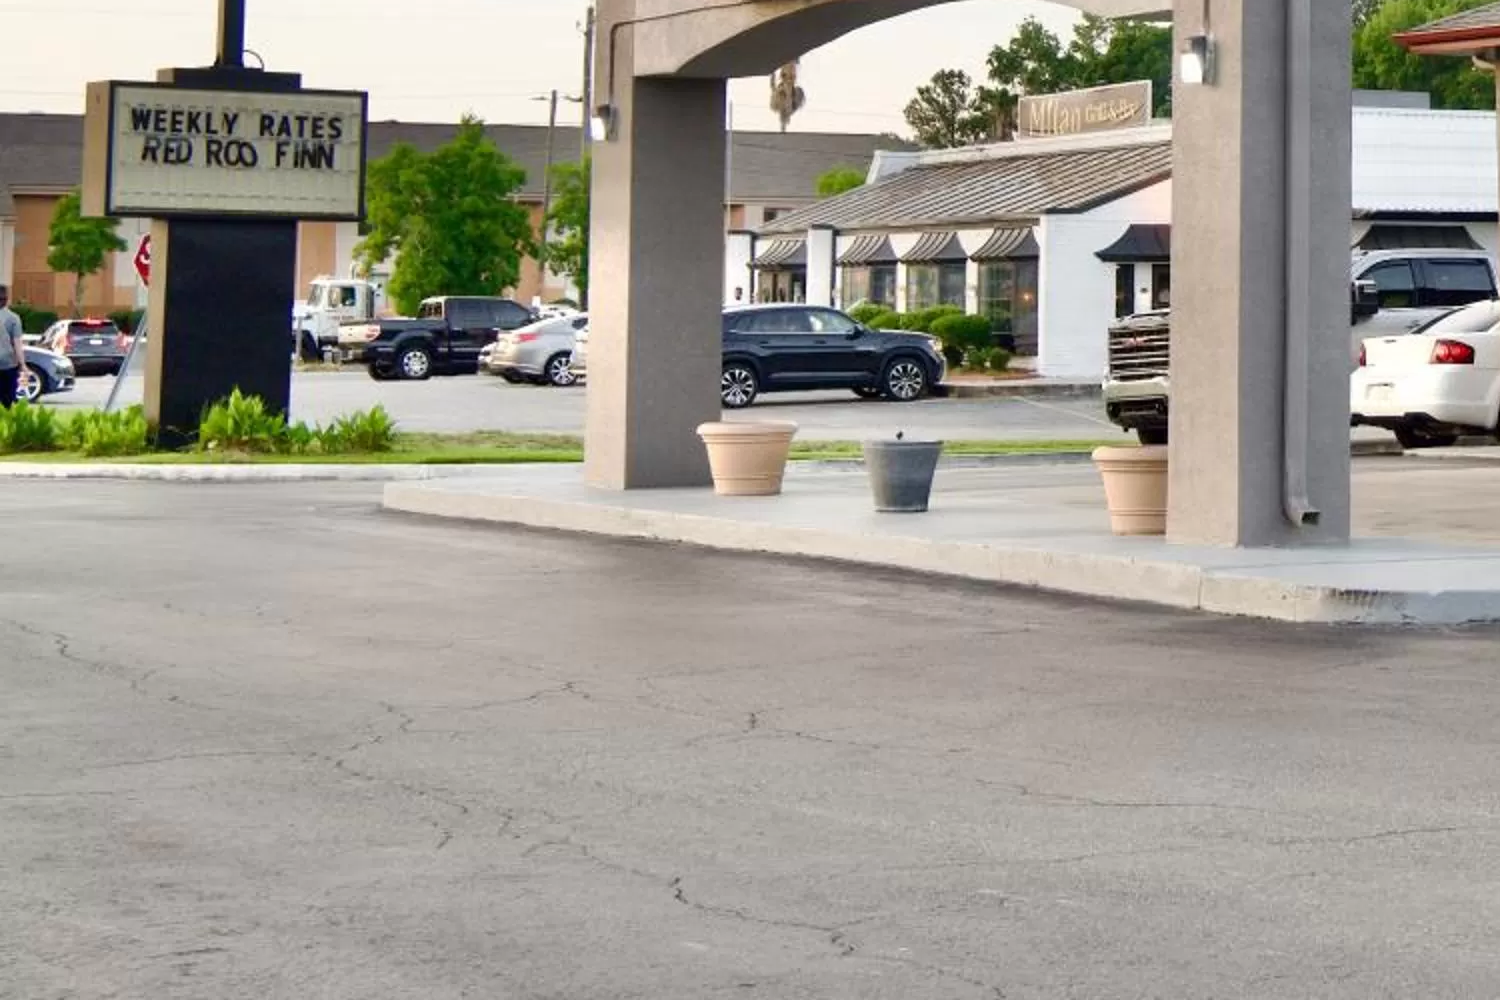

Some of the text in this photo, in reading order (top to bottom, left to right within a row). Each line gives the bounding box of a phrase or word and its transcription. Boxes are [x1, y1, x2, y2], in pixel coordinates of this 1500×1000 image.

[131, 108, 343, 139] WEEKLY RATES
[141, 136, 193, 165] RED
[206, 138, 259, 169] ROO
